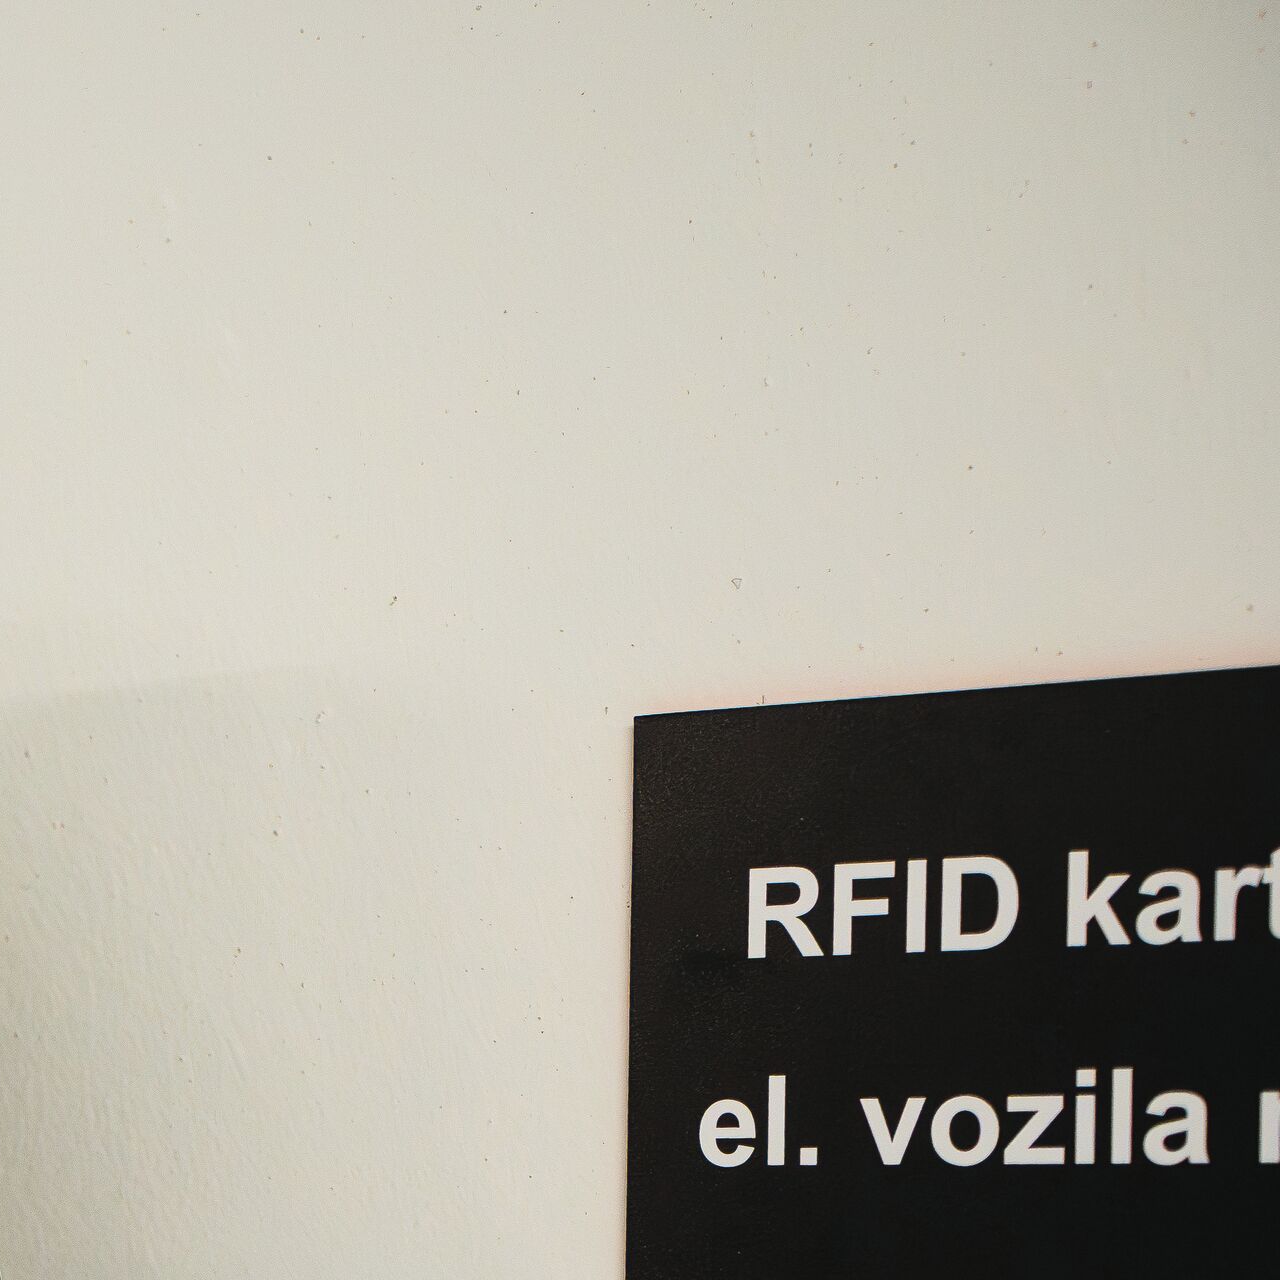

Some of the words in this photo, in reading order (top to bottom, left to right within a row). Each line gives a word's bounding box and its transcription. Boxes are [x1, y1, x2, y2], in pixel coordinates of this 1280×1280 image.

[747, 856, 1019, 959] RFID
[698, 1075, 818, 1168] el.
[860, 1068, 1209, 1167] vozila
